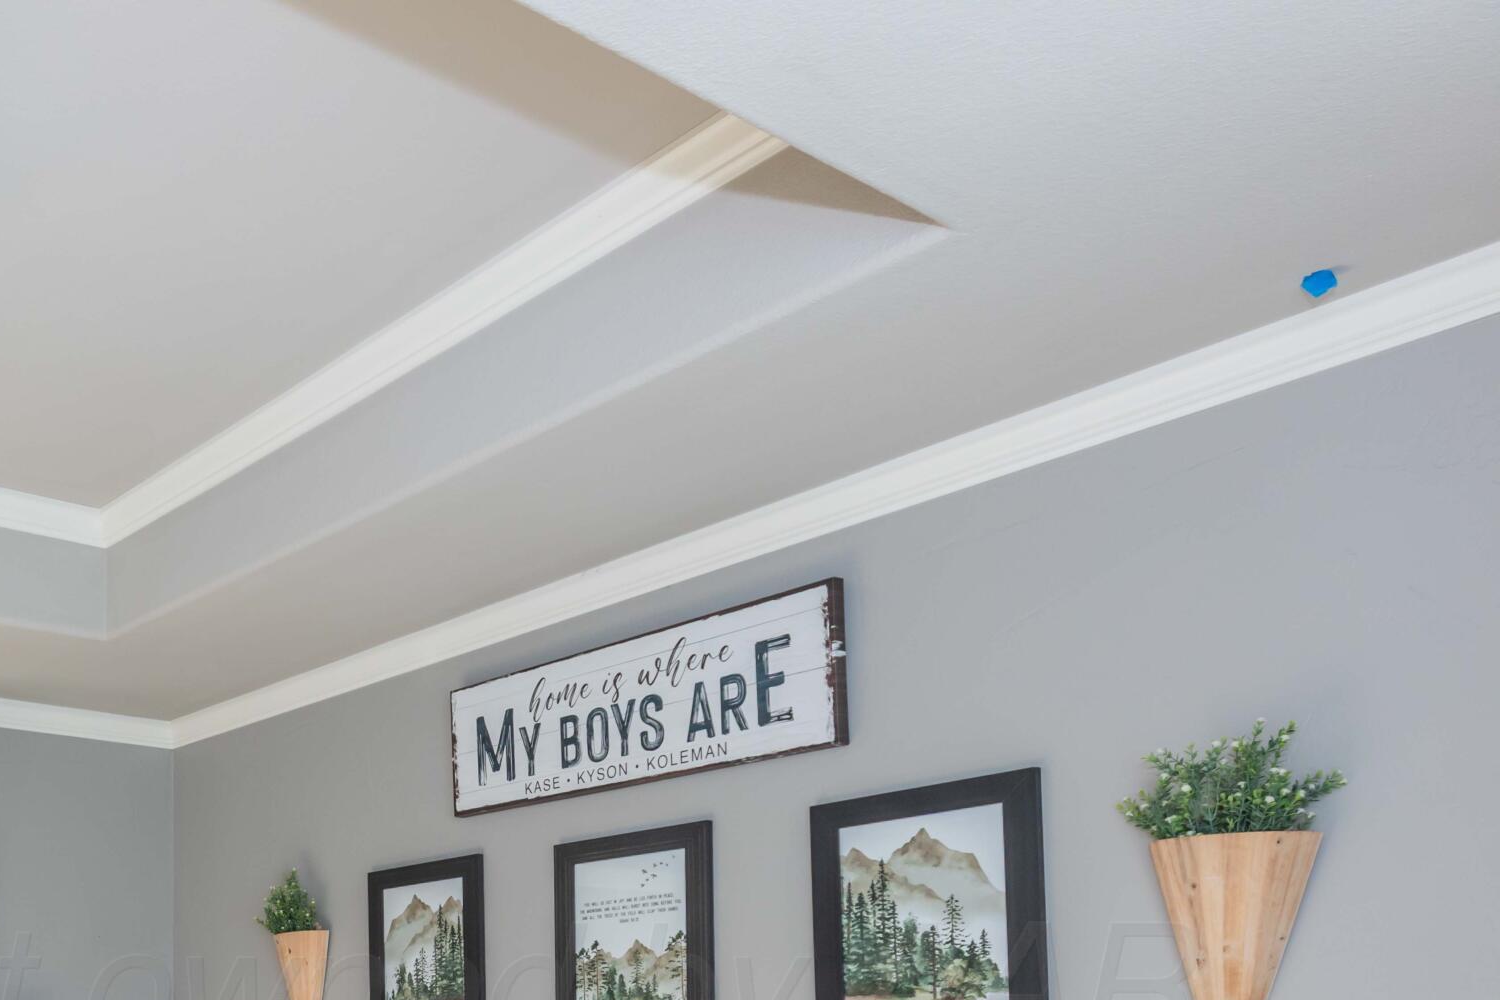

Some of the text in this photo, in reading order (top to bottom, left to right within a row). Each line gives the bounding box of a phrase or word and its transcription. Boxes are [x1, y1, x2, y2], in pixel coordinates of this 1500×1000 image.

[475, 633, 795, 787] MY BOYS ARE
[528, 636, 734, 723] home is where
[524, 741, 728, 795] KASE KYSON KOLEMAN
